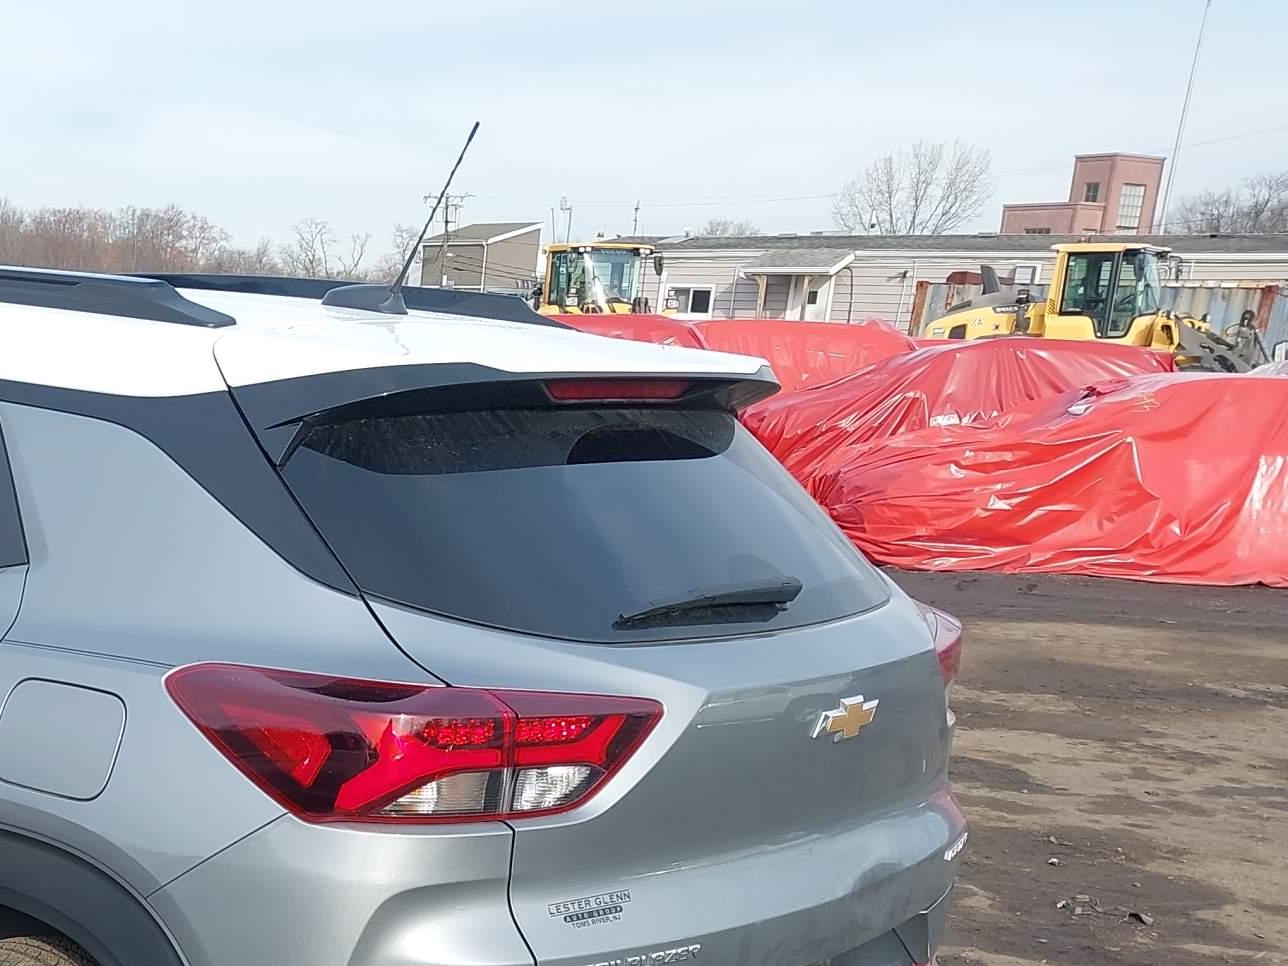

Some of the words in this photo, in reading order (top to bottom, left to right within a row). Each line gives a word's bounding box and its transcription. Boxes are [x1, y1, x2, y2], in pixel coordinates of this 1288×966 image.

[548, 899, 592, 915] LESTER
[594, 891, 631, 906] GLENN
[566, 912, 589, 922] AUTO
[571, 920, 591, 928] TOMS
